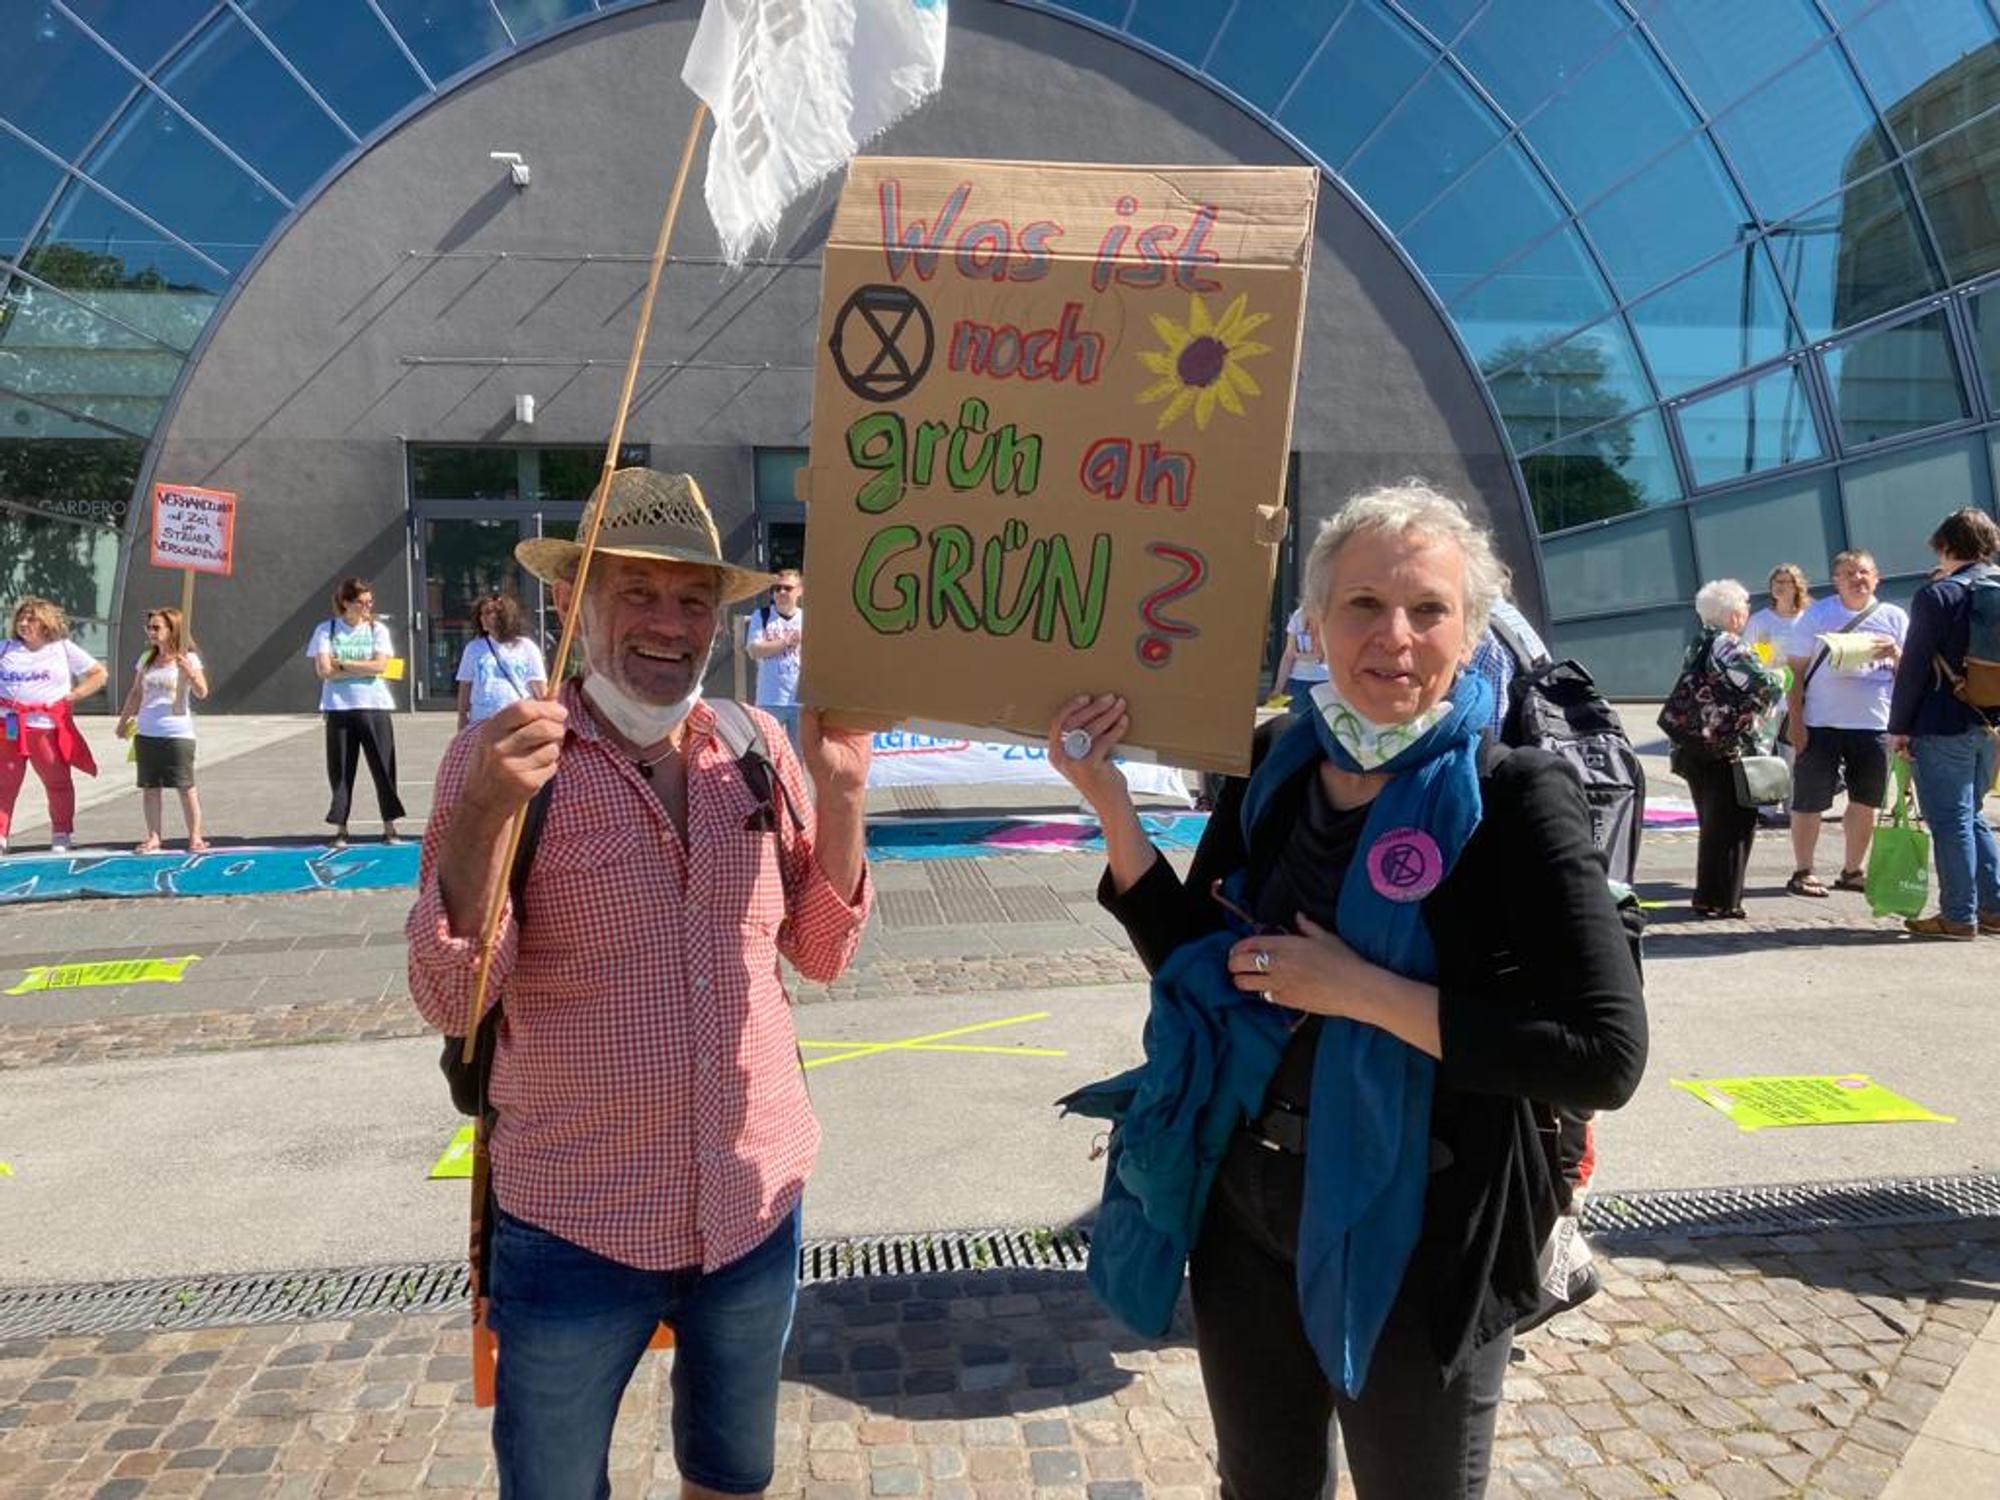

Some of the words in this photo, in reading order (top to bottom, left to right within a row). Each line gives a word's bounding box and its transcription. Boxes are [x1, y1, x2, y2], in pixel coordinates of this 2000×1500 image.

[879, 180, 1064, 283] Was
[1091, 195, 1224, 293] ist
[948, 302, 1106, 383] noch
[845, 397, 1043, 514] grün
[1080, 437, 1195, 508] an
[852, 519, 1112, 650] GRÜN
[1136, 540, 1209, 669] ?
